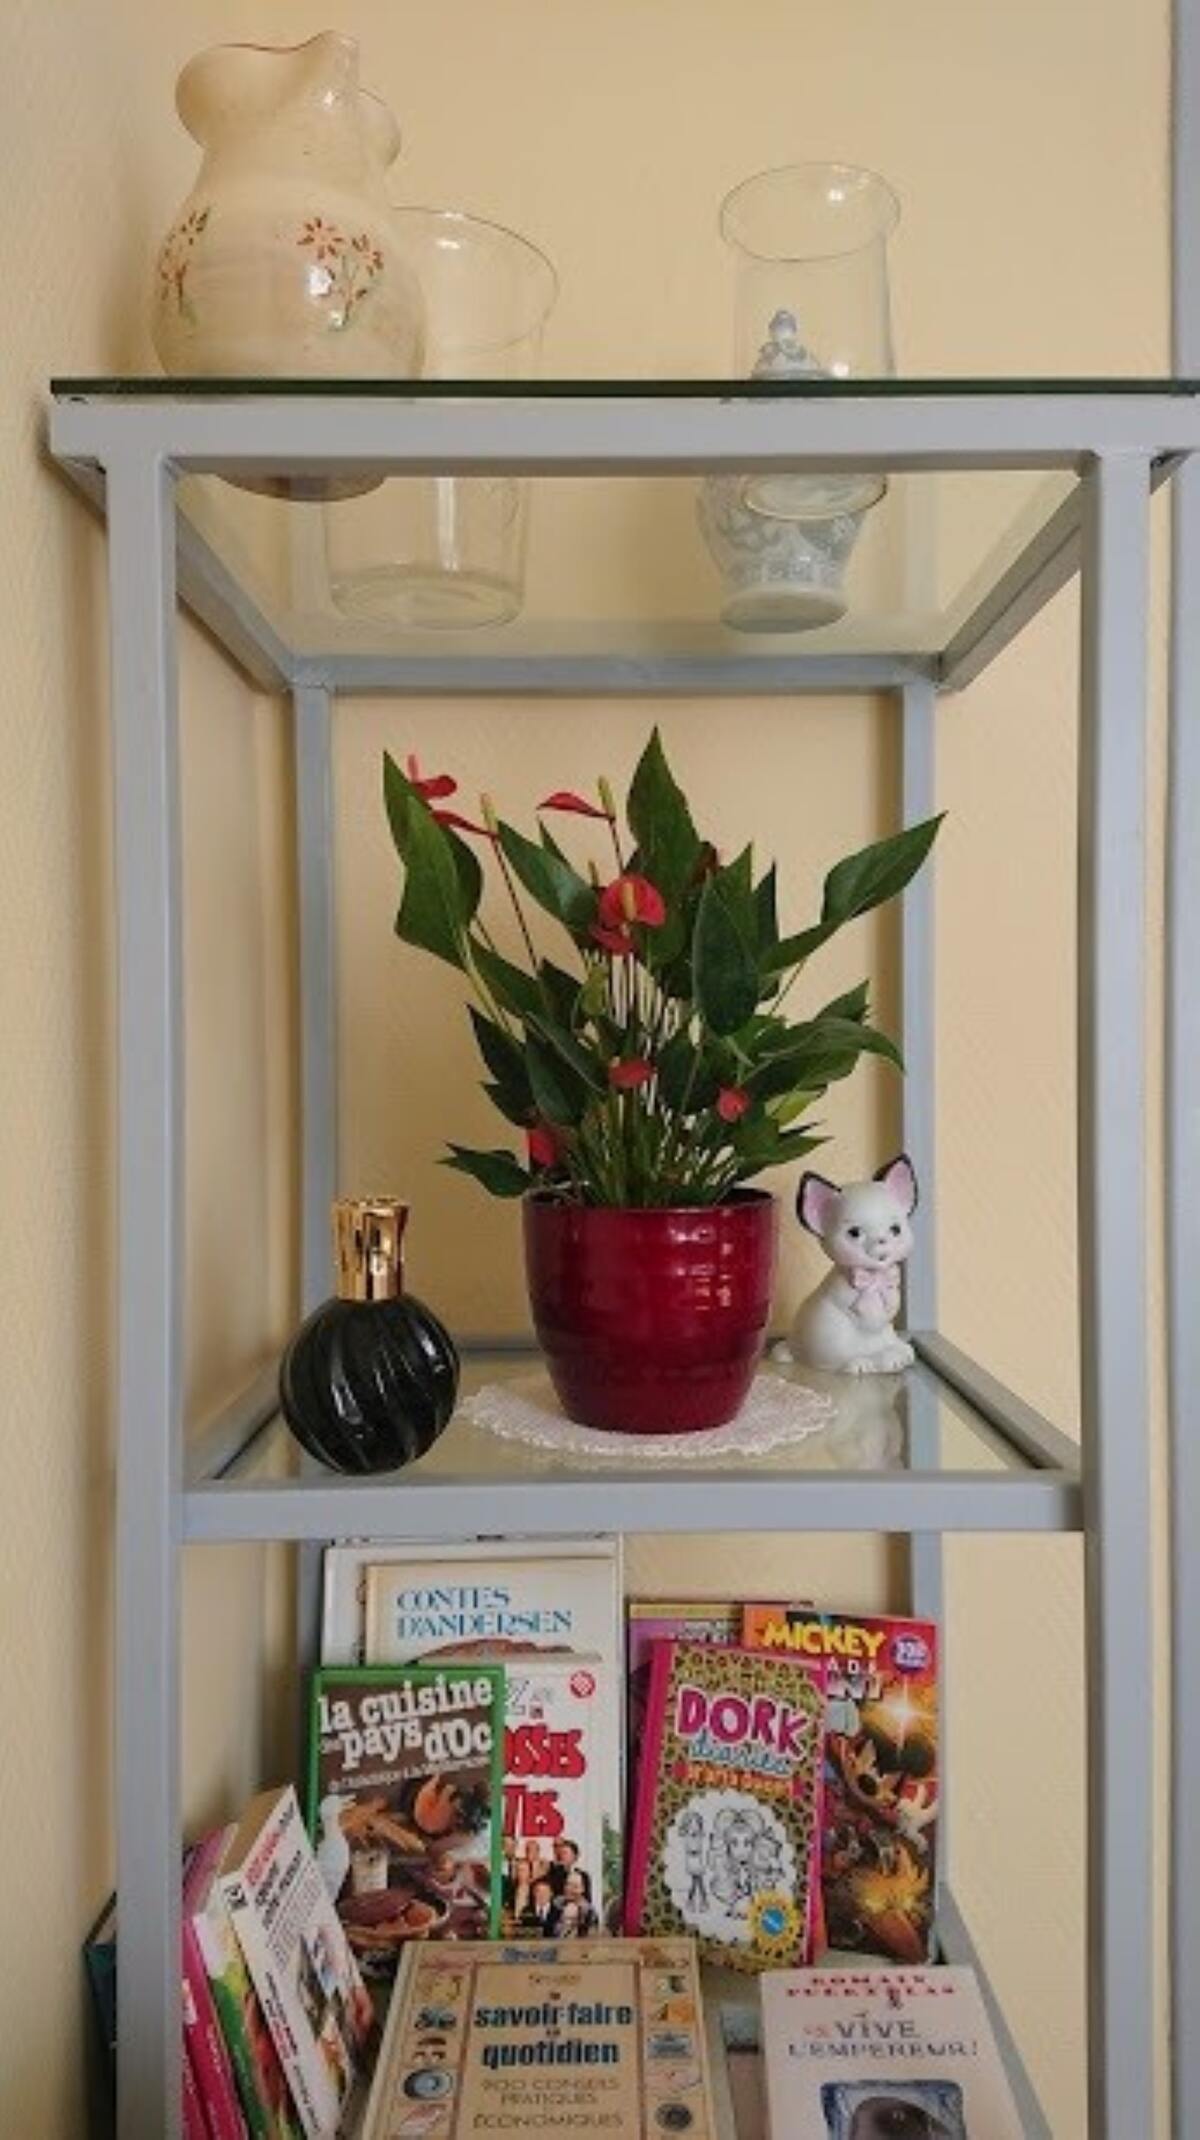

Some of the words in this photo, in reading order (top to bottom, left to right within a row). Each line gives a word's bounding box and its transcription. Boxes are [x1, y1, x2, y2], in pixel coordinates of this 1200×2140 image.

[397, 1587, 511, 1611] CONTES
[397, 1611, 572, 1639] D'ANDERSEN
[762, 1621, 886, 1657] MICKEY
[317, 1694, 355, 1734] la
[360, 1673, 493, 1725] cuisine
[677, 1688, 808, 1758] DORK
[339, 1718, 424, 1771] pays
[474, 2002, 632, 2028] savoir-faire
[483, 2040, 620, 2069] quotidien
